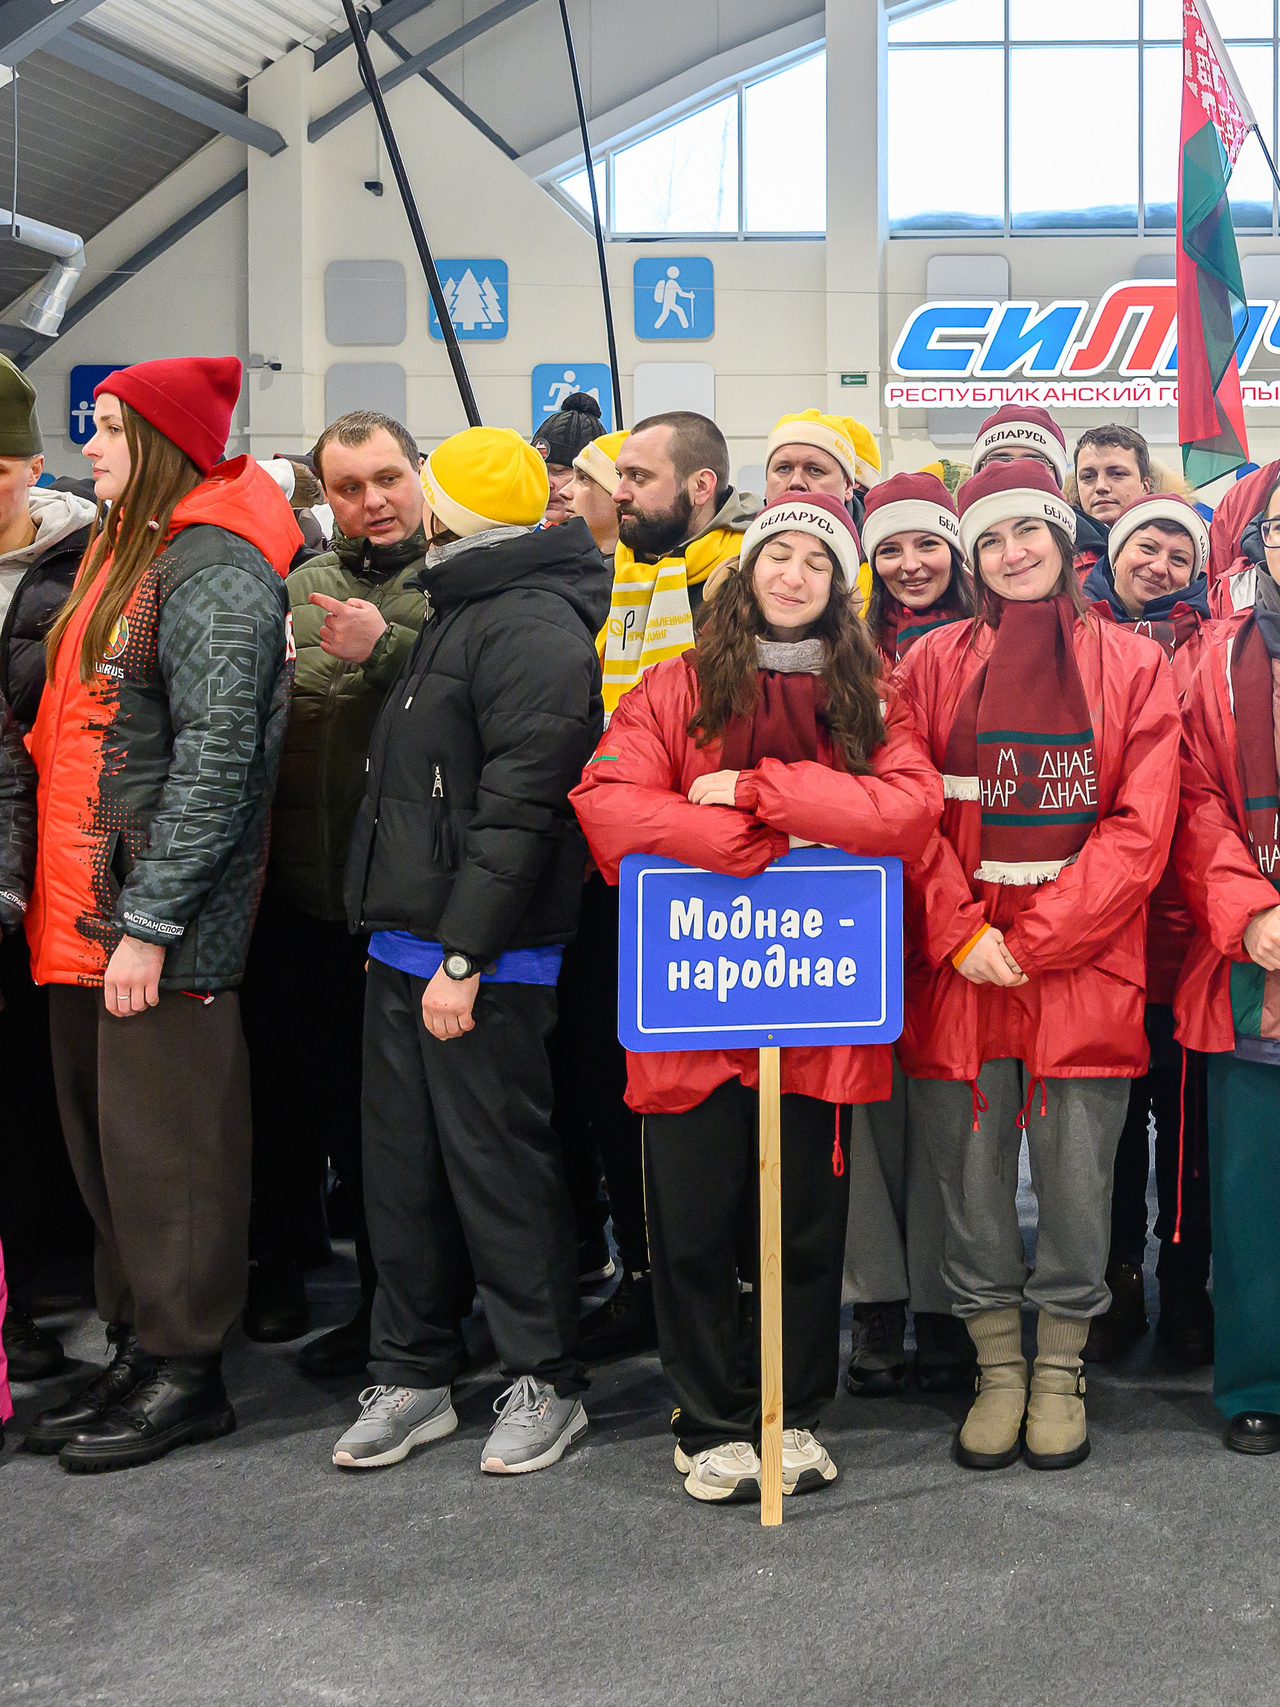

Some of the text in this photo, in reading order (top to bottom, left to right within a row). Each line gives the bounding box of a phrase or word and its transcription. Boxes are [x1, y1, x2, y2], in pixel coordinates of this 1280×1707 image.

[890, 384, 1150, 402] РЕСПУБЛИКАНСКИЙ
[984, 429, 1047, 447] БЕЛАРУСЬ
[760, 511, 835, 535] БЕЛАРУСЬ
[669, 895, 823, 941] Моднае
[667, 944, 857, 1003] народнае
